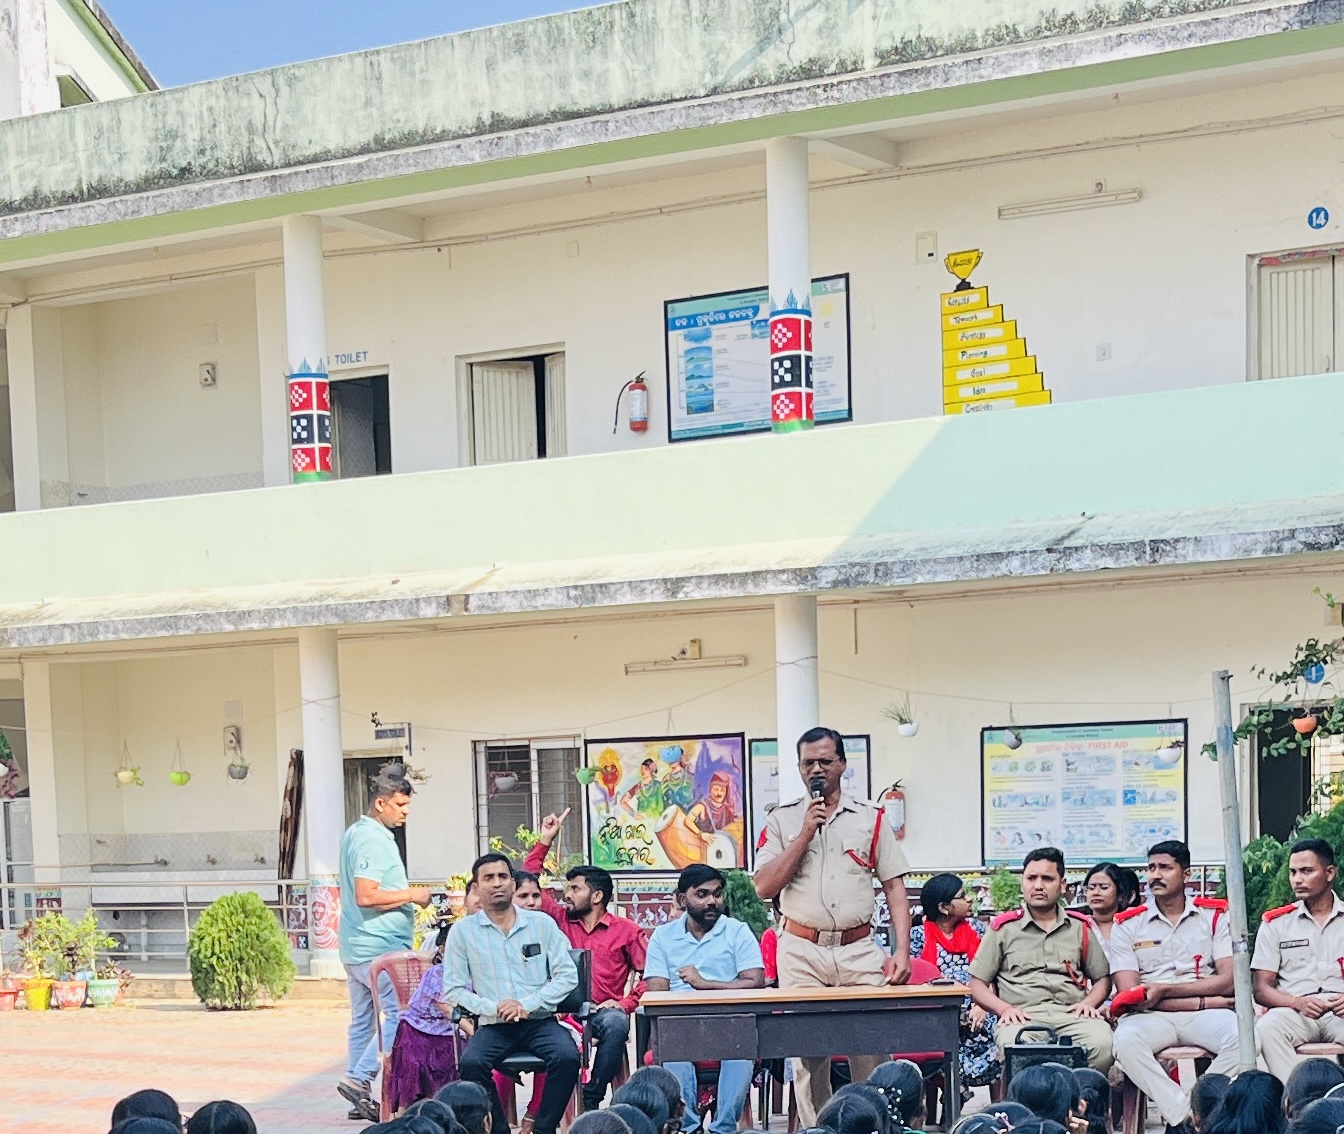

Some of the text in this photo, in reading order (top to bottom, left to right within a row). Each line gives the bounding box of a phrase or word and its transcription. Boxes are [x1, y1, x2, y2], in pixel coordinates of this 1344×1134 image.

[1312, 210, 1326, 227] 14
[335, 351, 368, 365] TOILET
[1088, 740, 1129, 750] FIRST AID
